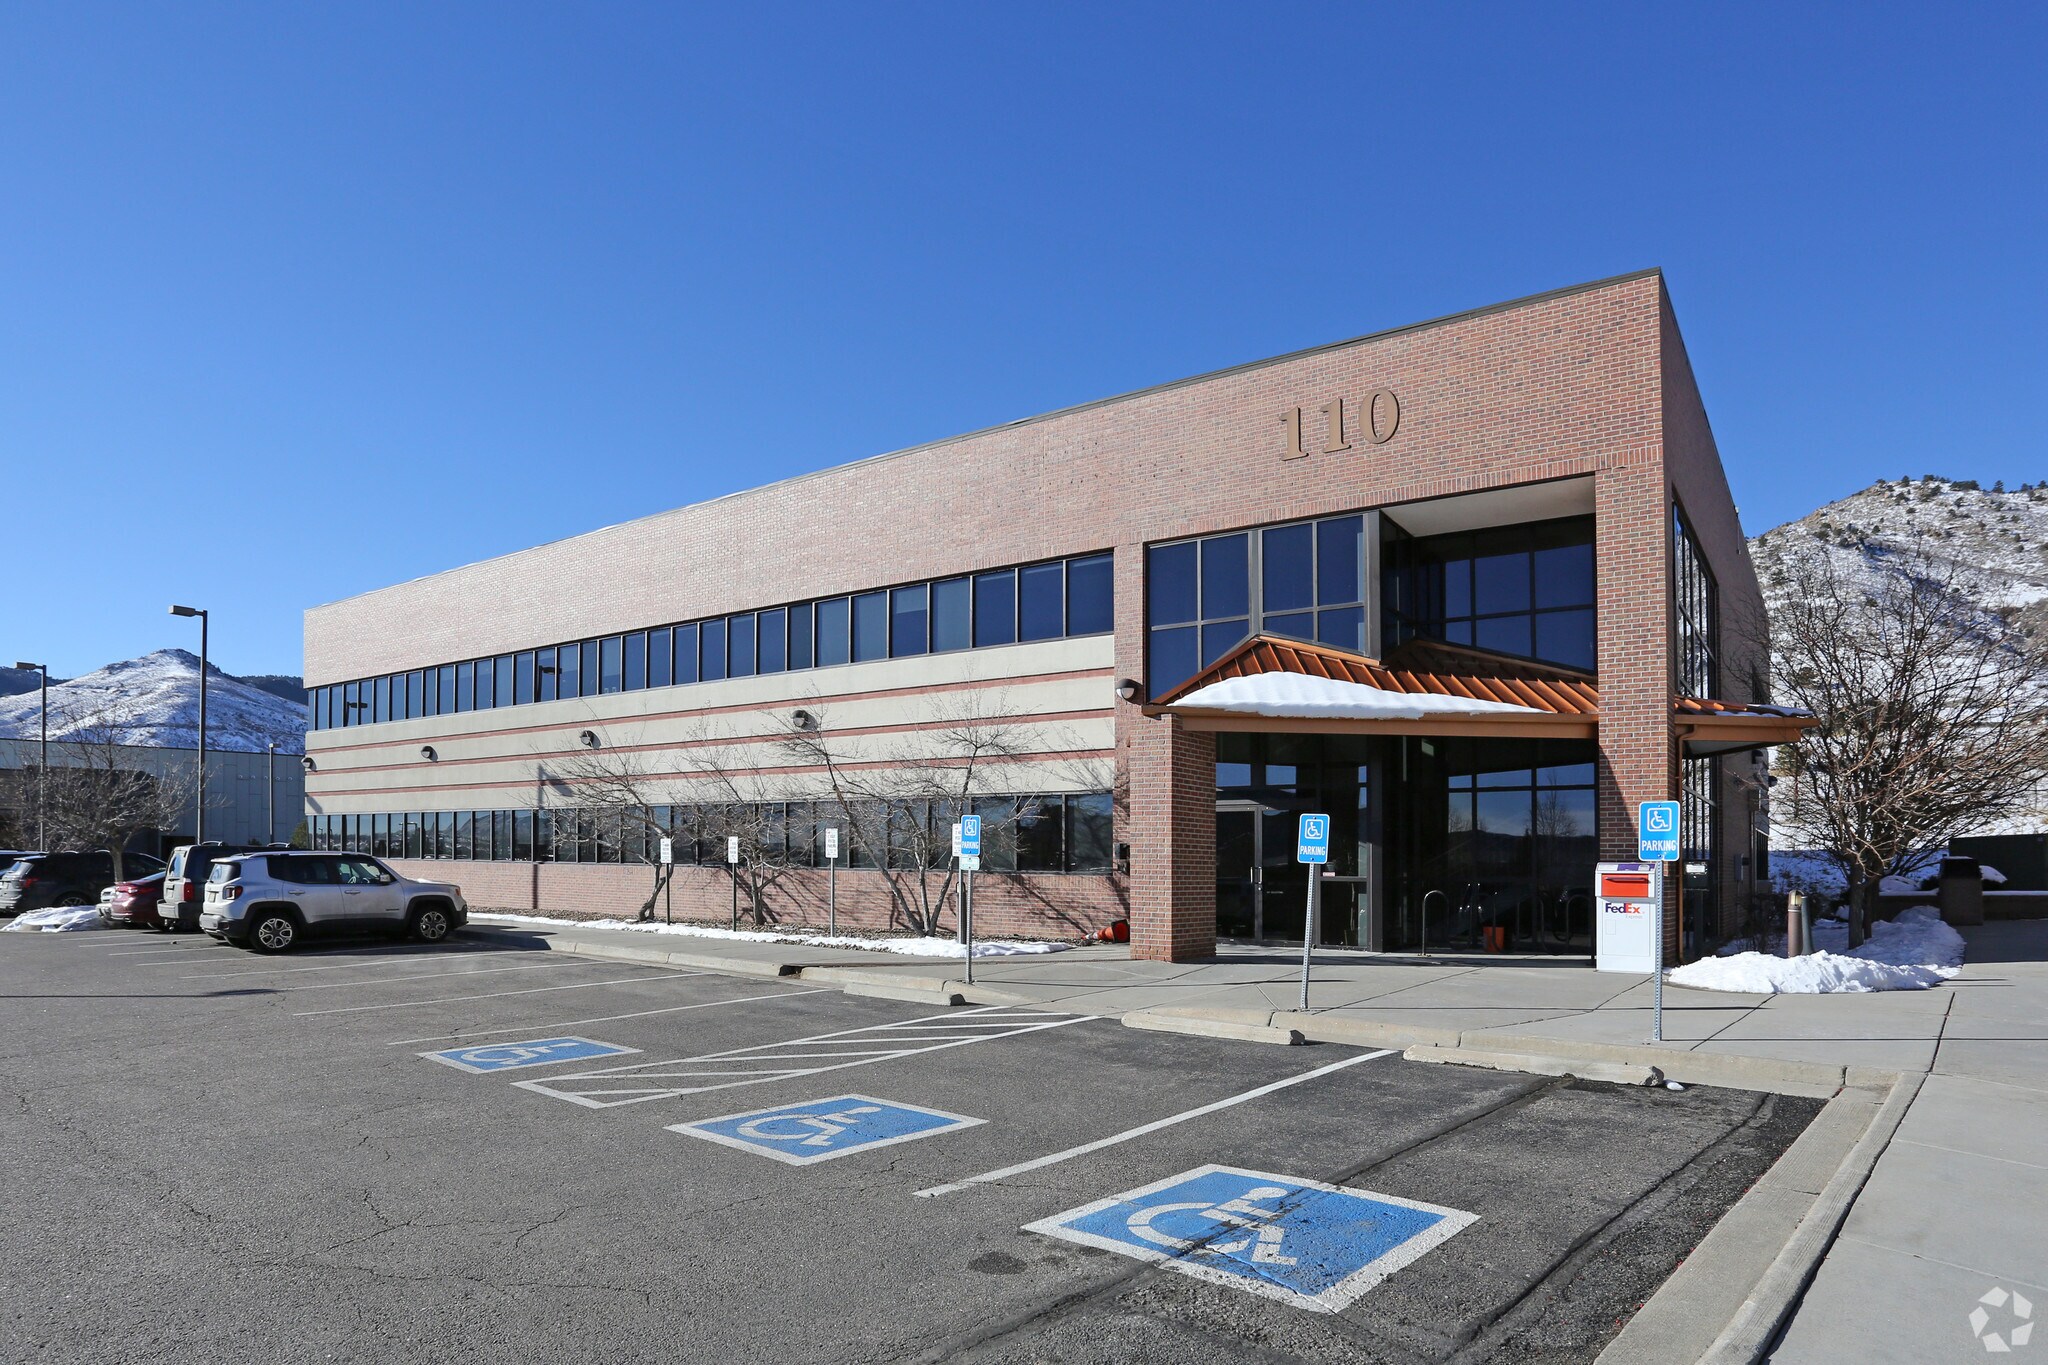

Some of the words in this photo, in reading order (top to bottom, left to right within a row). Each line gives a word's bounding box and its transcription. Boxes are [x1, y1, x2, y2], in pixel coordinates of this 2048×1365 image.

[1279, 388, 1400, 462] 110
[962, 841, 979, 849] PARKING
[1299, 845, 1326, 856] PARKING
[1641, 840, 1676, 851] PARKING
[1605, 902, 1640, 913] FedEx
